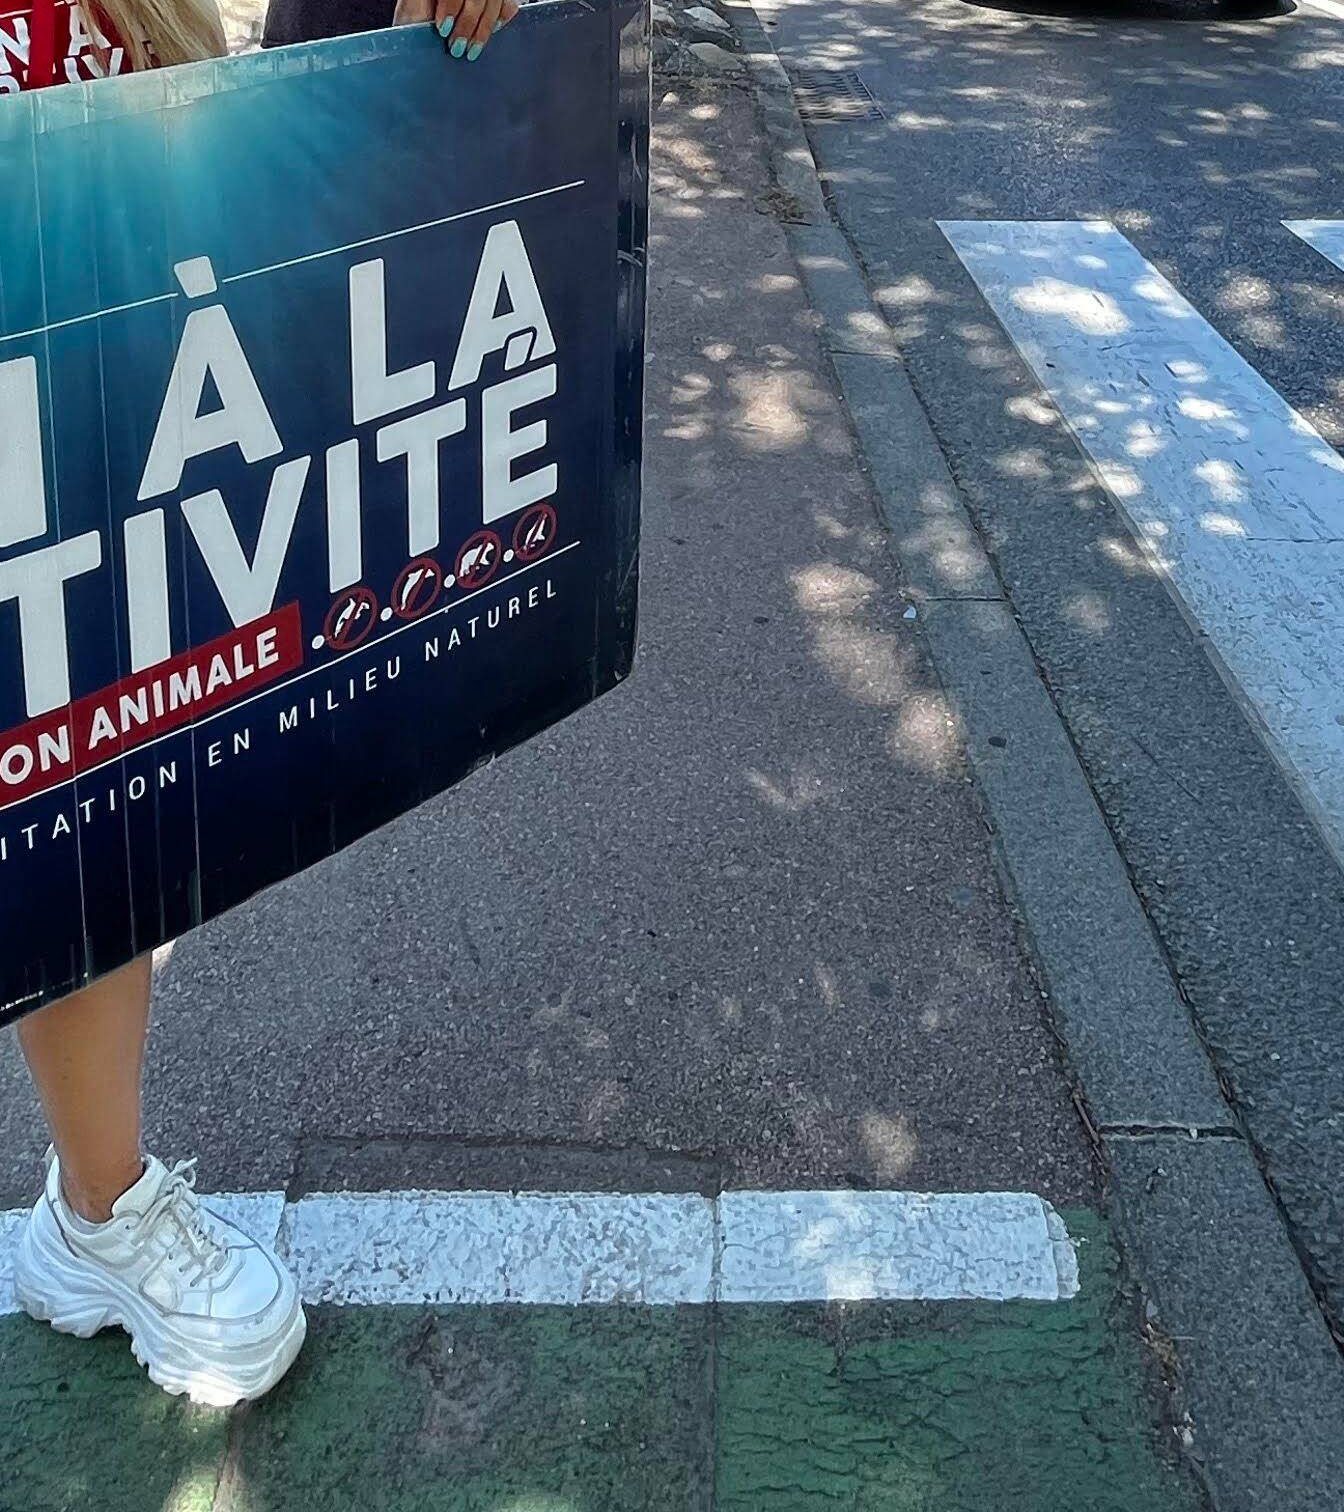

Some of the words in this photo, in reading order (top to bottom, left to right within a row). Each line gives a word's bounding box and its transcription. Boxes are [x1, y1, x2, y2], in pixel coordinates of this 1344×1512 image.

[136, 255, 284, 501] À
[348, 219, 557, 426] LA
[87, 626, 280, 751] ANIMALE
[207, 727, 252, 768] EN
[278, 655, 401, 734] MILIEU
[423, 579, 559, 664] NATUREL
